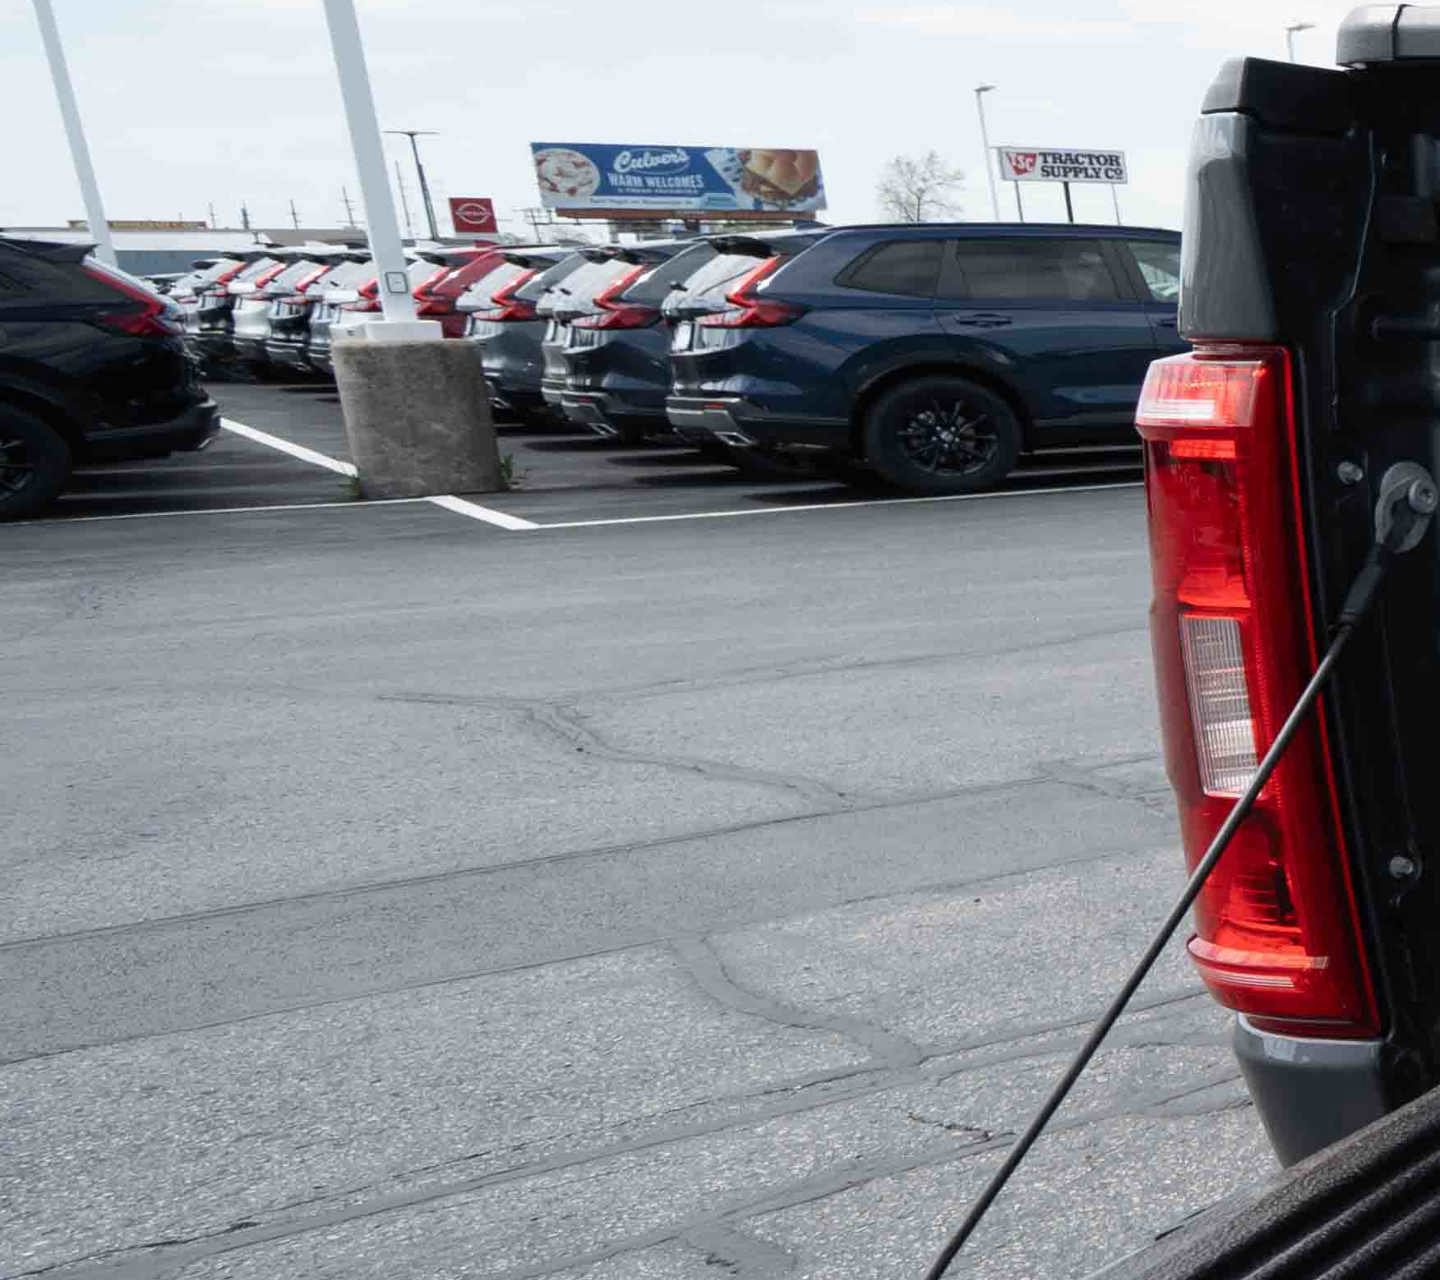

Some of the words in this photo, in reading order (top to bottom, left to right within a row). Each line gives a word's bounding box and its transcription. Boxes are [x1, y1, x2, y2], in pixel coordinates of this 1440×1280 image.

[1039, 152, 1121, 166] TRACTOR
[1040, 165, 1101, 179] SUPPLY
[607, 173, 643, 187] WARM
[645, 174, 704, 188] WELCOMES
